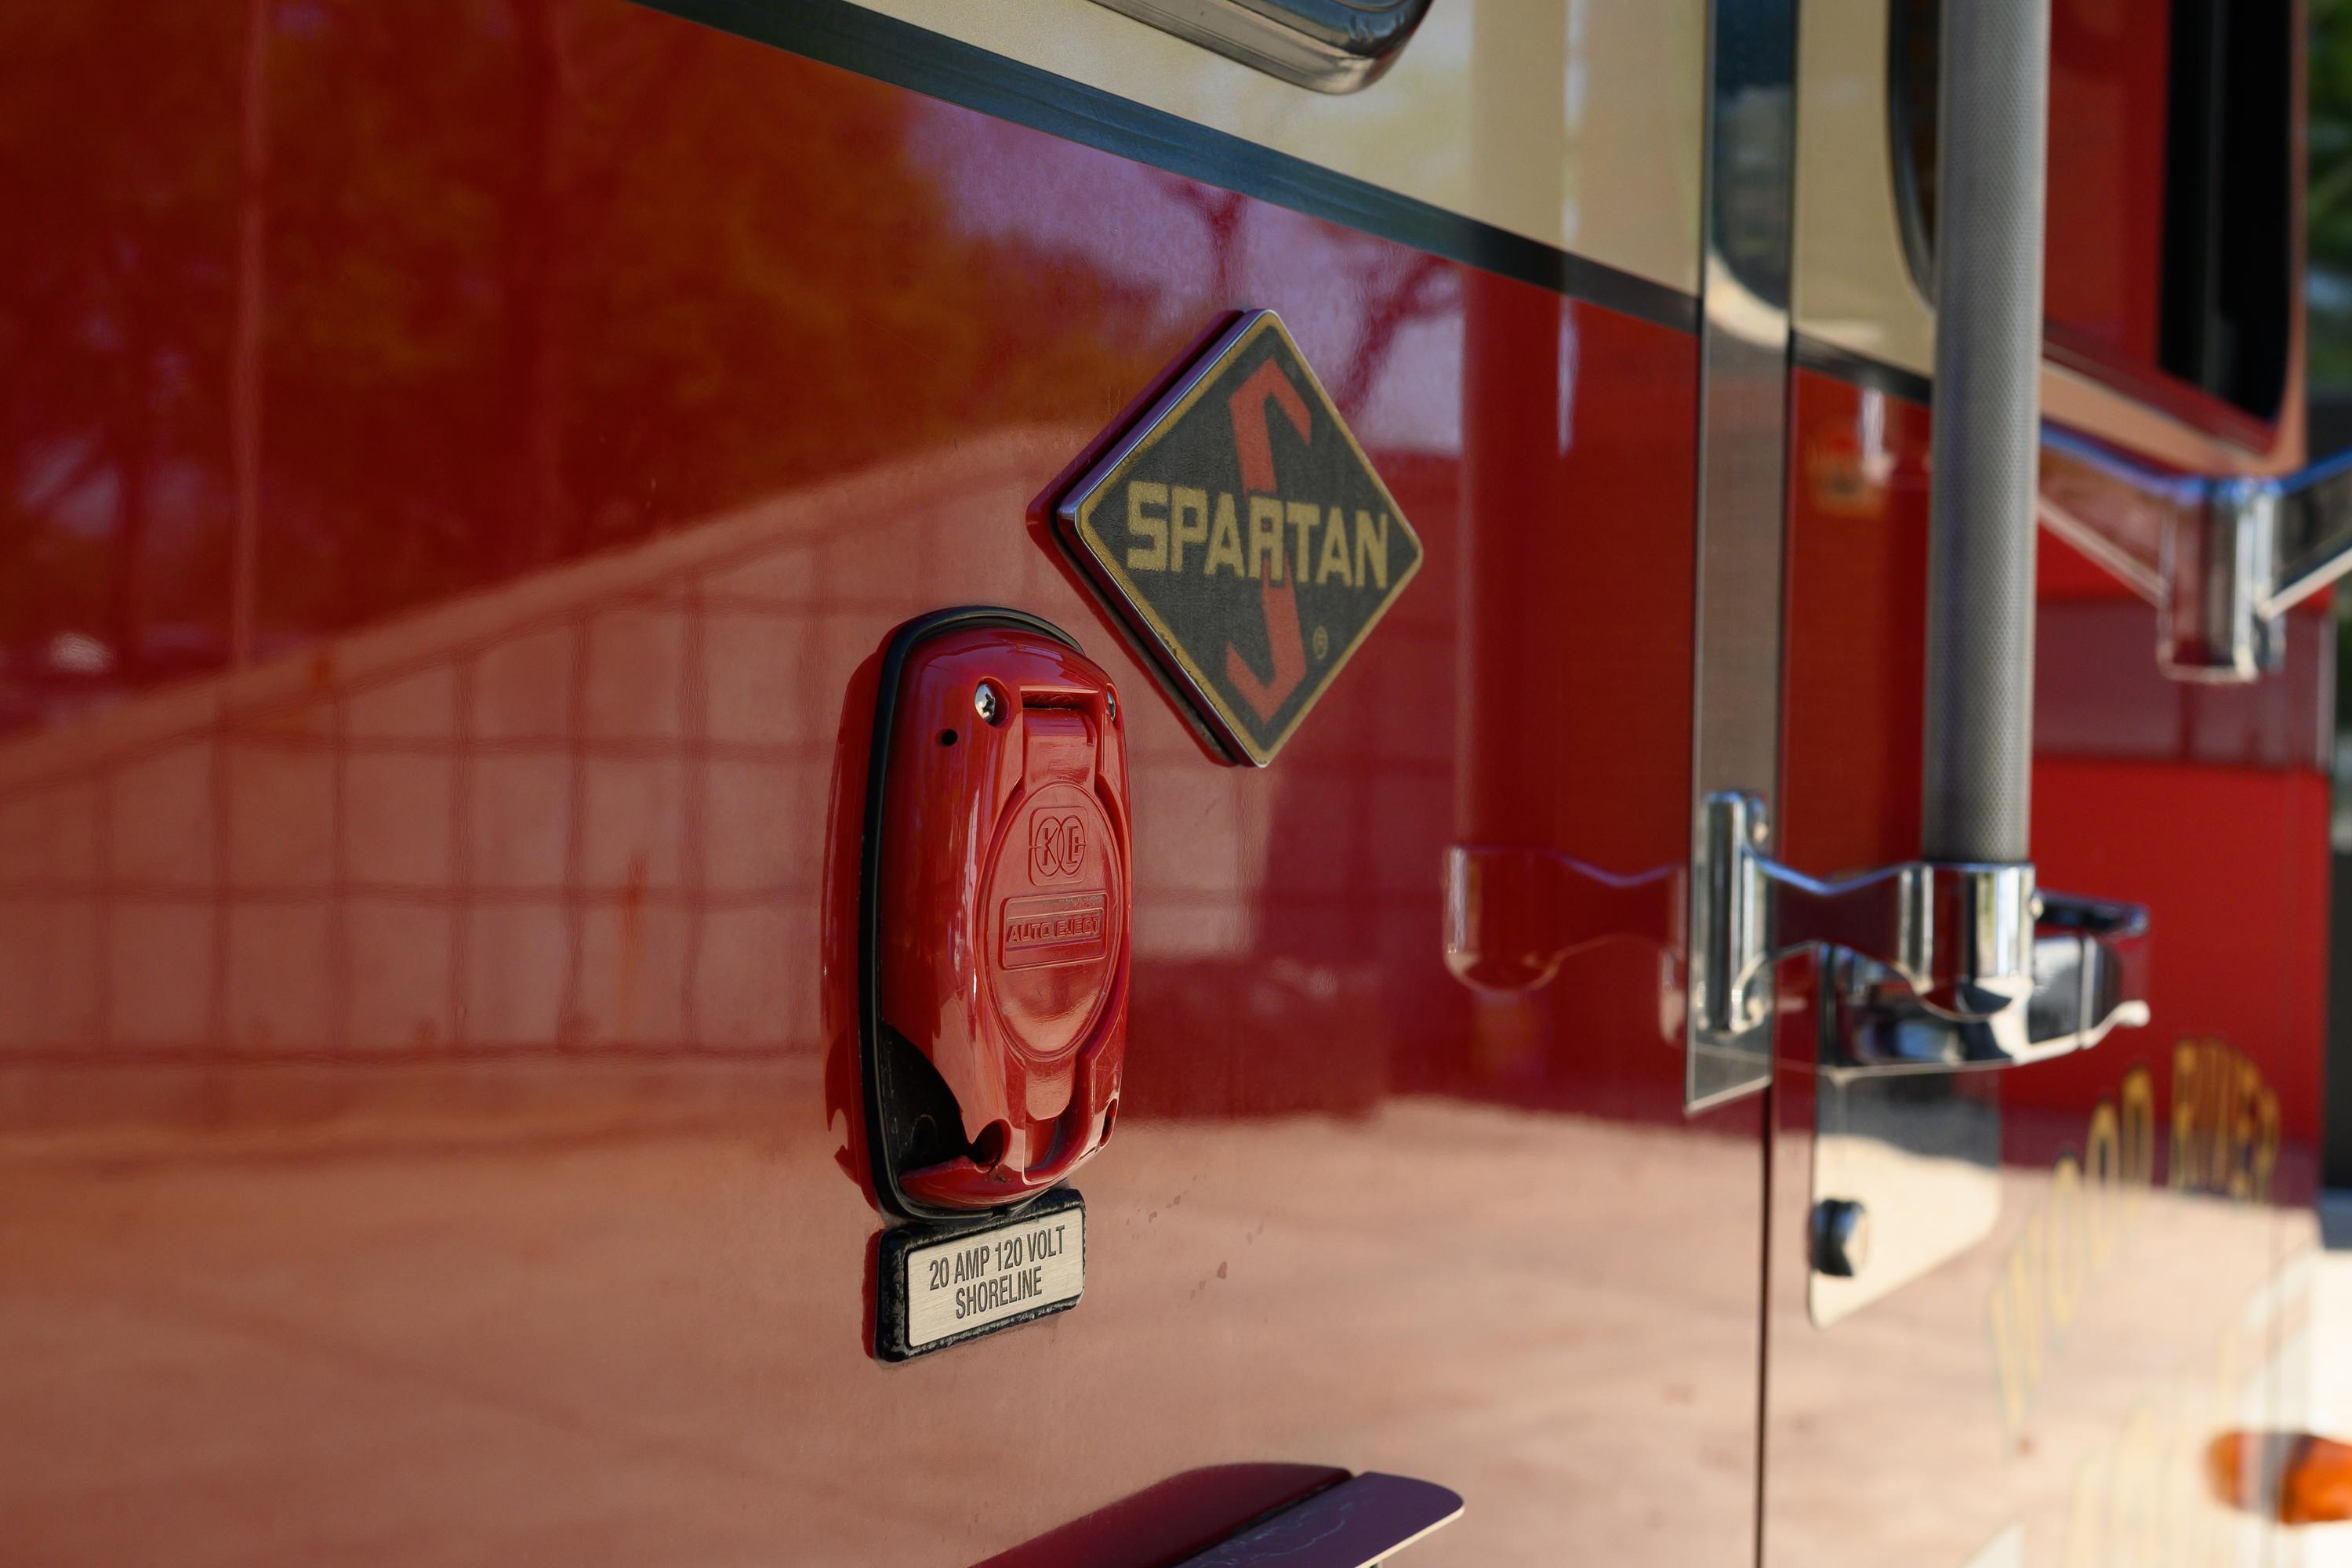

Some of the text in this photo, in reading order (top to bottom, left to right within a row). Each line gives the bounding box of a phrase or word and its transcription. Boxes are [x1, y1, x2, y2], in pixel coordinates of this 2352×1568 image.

[1127, 480, 1389, 590] SPARTAN
[1005, 916, 1102, 943] AUTO EJECT
[928, 1225, 1065, 1291] 20 AMP 120 VOLT
[955, 1265, 1043, 1319] SHORELINE
